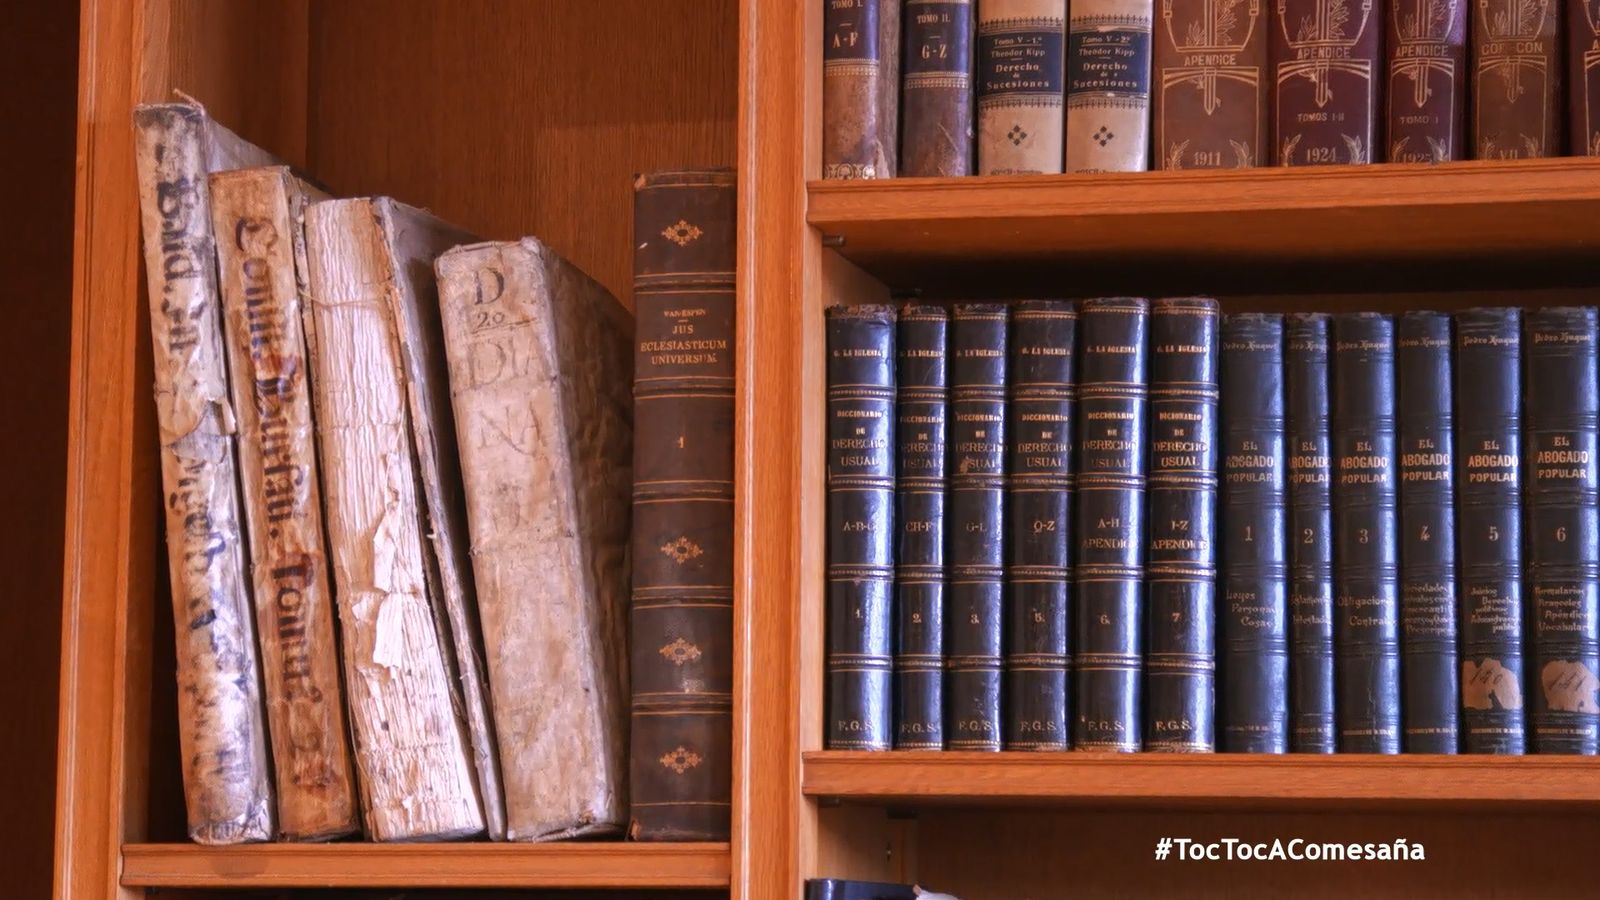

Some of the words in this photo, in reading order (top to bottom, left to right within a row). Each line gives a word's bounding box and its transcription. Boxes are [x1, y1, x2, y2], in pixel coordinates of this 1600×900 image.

[917, 14, 939, 24] TOMO
[991, 48, 1023, 58] Theodor
[1026, 47, 1046, 57] Kipp
[1079, 48, 1112, 57] Theodor
[1114, 47, 1135, 57] Kipp
[1296, 47, 1351, 60] APENDICE
[1395, 44, 1449, 57] APENDICE
[1184, 54, 1237, 66] APENDICE
[995, 62, 1040, 73] Derecho
[1082, 62, 1128, 72] Derecho
[986, 80, 1050, 90] Sucesiones
[1073, 79, 1137, 89] Sucesiones
[1296, 112, 1328, 122] TOMOS
[1400, 115, 1430, 125] TOMO
[1193, 151, 1222, 166] 1911
[1306, 147, 1337, 163] 1924
[474, 267, 504, 306] D
[672, 325, 694, 335] JUS
[1464, 335, 1488, 347] Pedro
[1535, 332, 1558, 342] Pedro
[640, 340, 728, 352] ECLESIASTICUM
[1031, 347, 1041, 355] LA
[1043, 347, 1070, 355] IGLESIA
[1107, 345, 1136, 353] IGLESIA
[1165, 345, 1175, 353] LA
[1178, 344, 1207, 353] IGLESIA
[843, 349, 852, 357] LA
[854, 349, 884, 357] IGLESIA
[837, 409, 883, 418] DICCIONARIO
[1022, 413, 1068, 421] DICCIONARIO
[1088, 412, 1135, 420] DICCIONARIO
[856, 427, 865, 435] DE
[918, 432, 928, 440] DE
[975, 430, 985, 438] DE
[1041, 431, 1052, 439] DE
[1107, 428, 1117, 436] DE
[1174, 428, 1184, 436] DE
[833, 440, 885, 450] DERECHO
[1083, 440, 1136, 450] DERECHO
[1154, 441, 1208, 452] DERECHO
[1242, 441, 1258, 450] EL
[1302, 441, 1317, 451] EL
[1357, 441, 1372, 451] EL
[1419, 439, 1434, 448] EL
[1484, 440, 1500, 450] EL
[1554, 437, 1570, 446] EL
[1018, 442, 1072, 453] DERECHO
[841, 455, 880, 466] USUAL
[1027, 456, 1064, 467] USUAL
[1161, 455, 1200, 466] USUAL
[1226, 455, 1275, 468] ABOGADO
[1341, 455, 1388, 468] ABOGADO
[1402, 453, 1450, 466] ABOGADO
[1468, 455, 1519, 467] ABOGADO
[1537, 451, 1589, 464] ABOGADO
[1227, 472, 1274, 482] POPULAR
[1341, 472, 1388, 483] POPULAR
[1402, 471, 1449, 481] POPULAR
[1469, 472, 1517, 482] POPULAR
[1538, 469, 1587, 479] POPULAR
[1245, 526, 1253, 542] 1
[1304, 528, 1314, 544] 2
[1360, 528, 1370, 544] 3
[1420, 525, 1431, 542] 4
[1489, 526, 1499, 542] 5
[1557, 527, 1567, 542] 6
